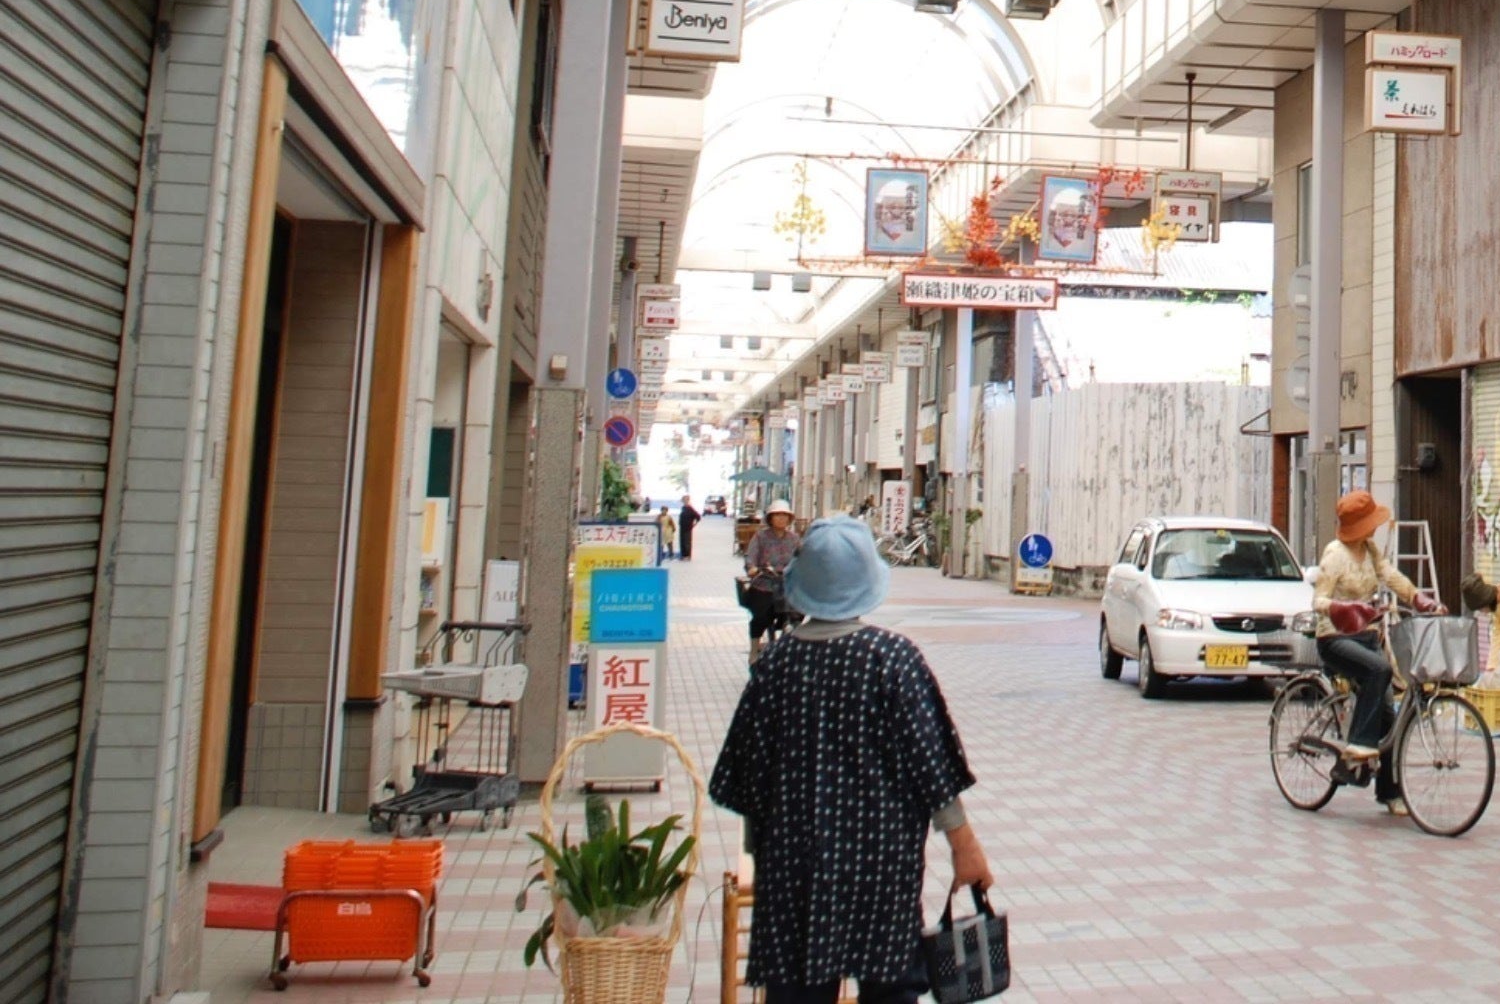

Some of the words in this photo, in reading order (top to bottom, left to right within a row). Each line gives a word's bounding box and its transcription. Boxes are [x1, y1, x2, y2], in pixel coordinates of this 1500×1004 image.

[664, 4, 728, 34] Beniya
[1391, 45, 1447, 59] ハミングロード
[603, 655, 650, 726] 紅屋
